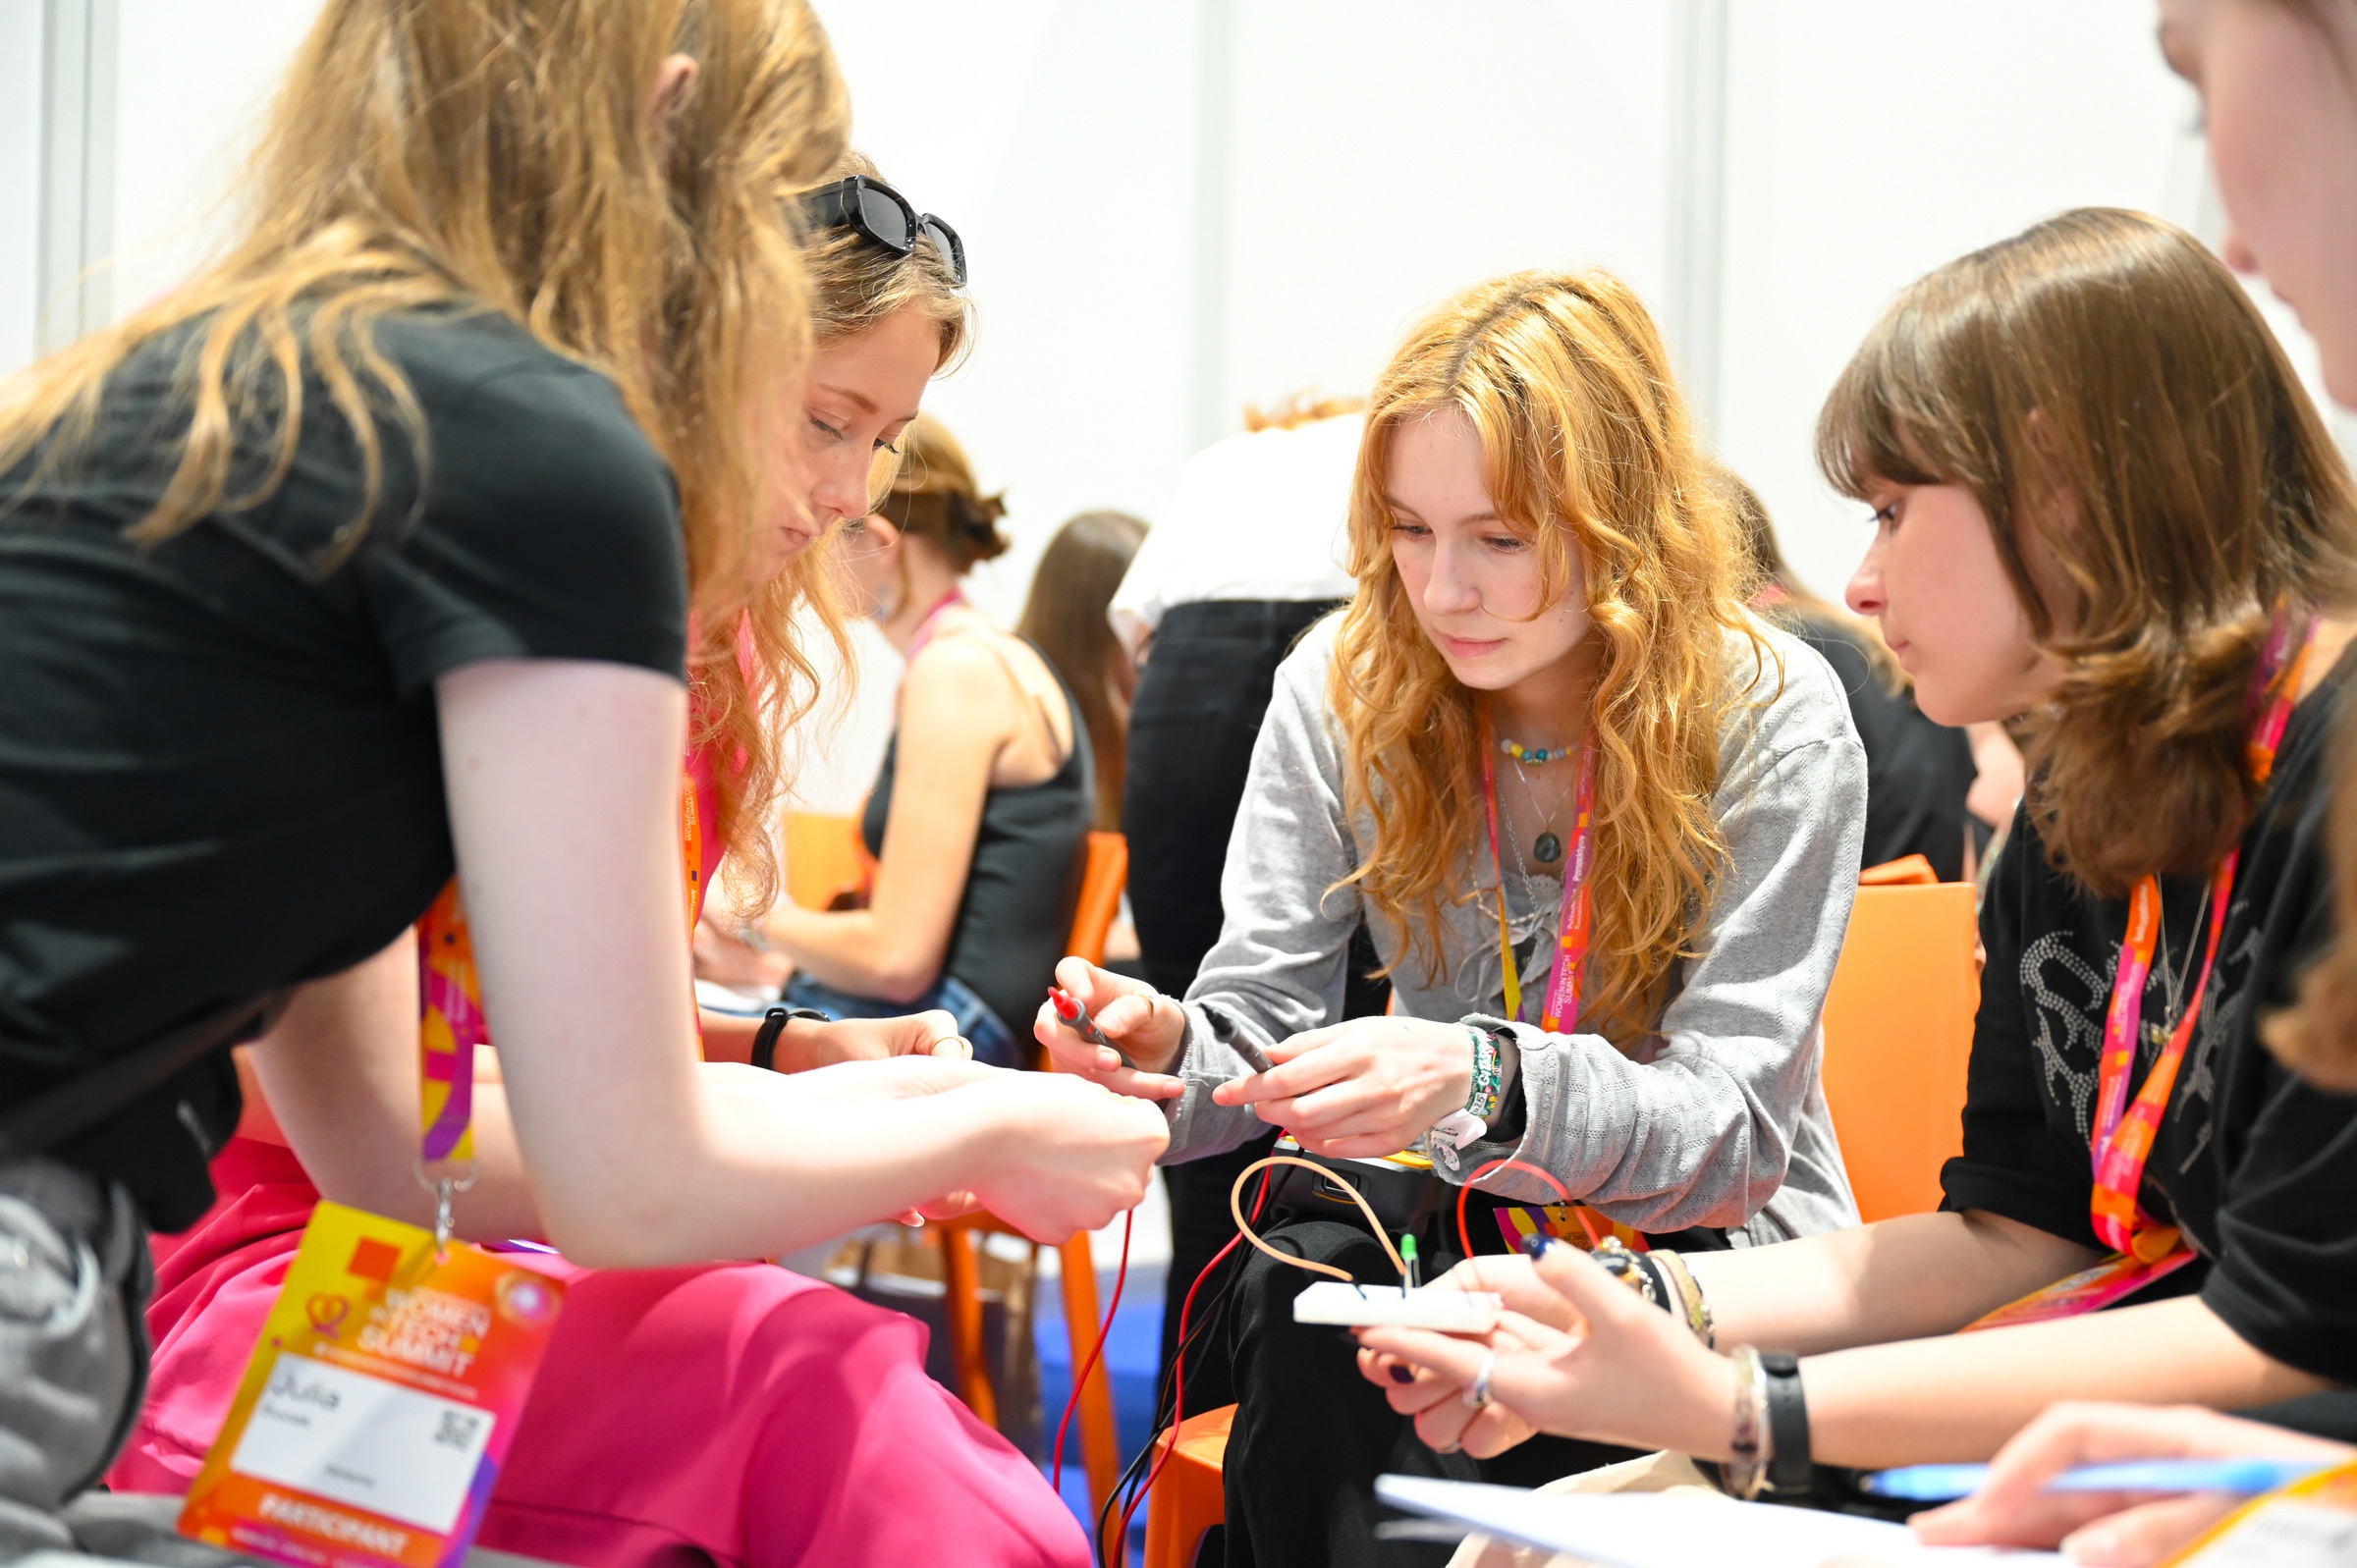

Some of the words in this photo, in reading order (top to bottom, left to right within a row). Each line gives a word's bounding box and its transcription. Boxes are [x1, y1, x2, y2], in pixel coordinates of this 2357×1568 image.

[1555, 987, 1565, 1017] WOMEN
[1561, 954, 1571, 977] TECH
[1564, 970, 1575, 1004] SUMMIT
[257, 1494, 407, 1554] PARTICIPANT
